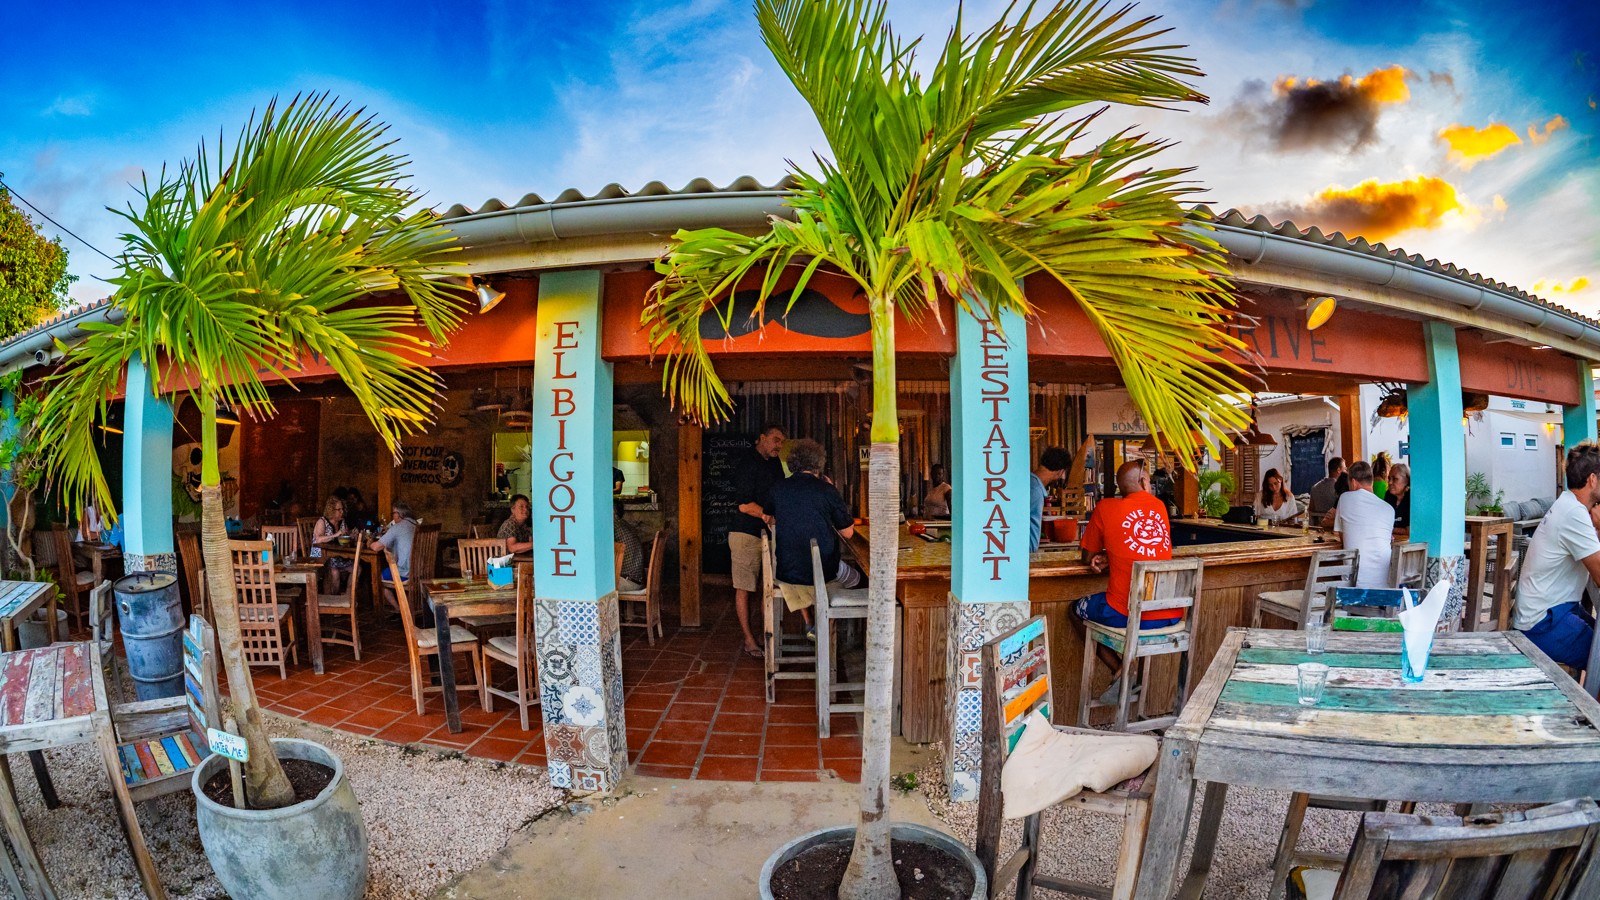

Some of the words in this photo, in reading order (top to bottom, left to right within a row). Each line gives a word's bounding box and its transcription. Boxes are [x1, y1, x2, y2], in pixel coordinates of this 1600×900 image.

[551, 321, 579, 379] EL
[1504, 357, 1546, 394] DIVE
[419, 446, 444, 458] YOUR
[979, 319, 1011, 581] RESTAURANT
[400, 472, 442, 484] GRINGOS
[549, 388, 577, 577] BIGOTE
[1121, 509, 1145, 529] DIVE
[1149, 510, 1170, 552] FRIENDS
[1124, 536, 1156, 557] TEAM
[210, 739, 230, 756] WATER
[231, 746, 243, 758] ME
